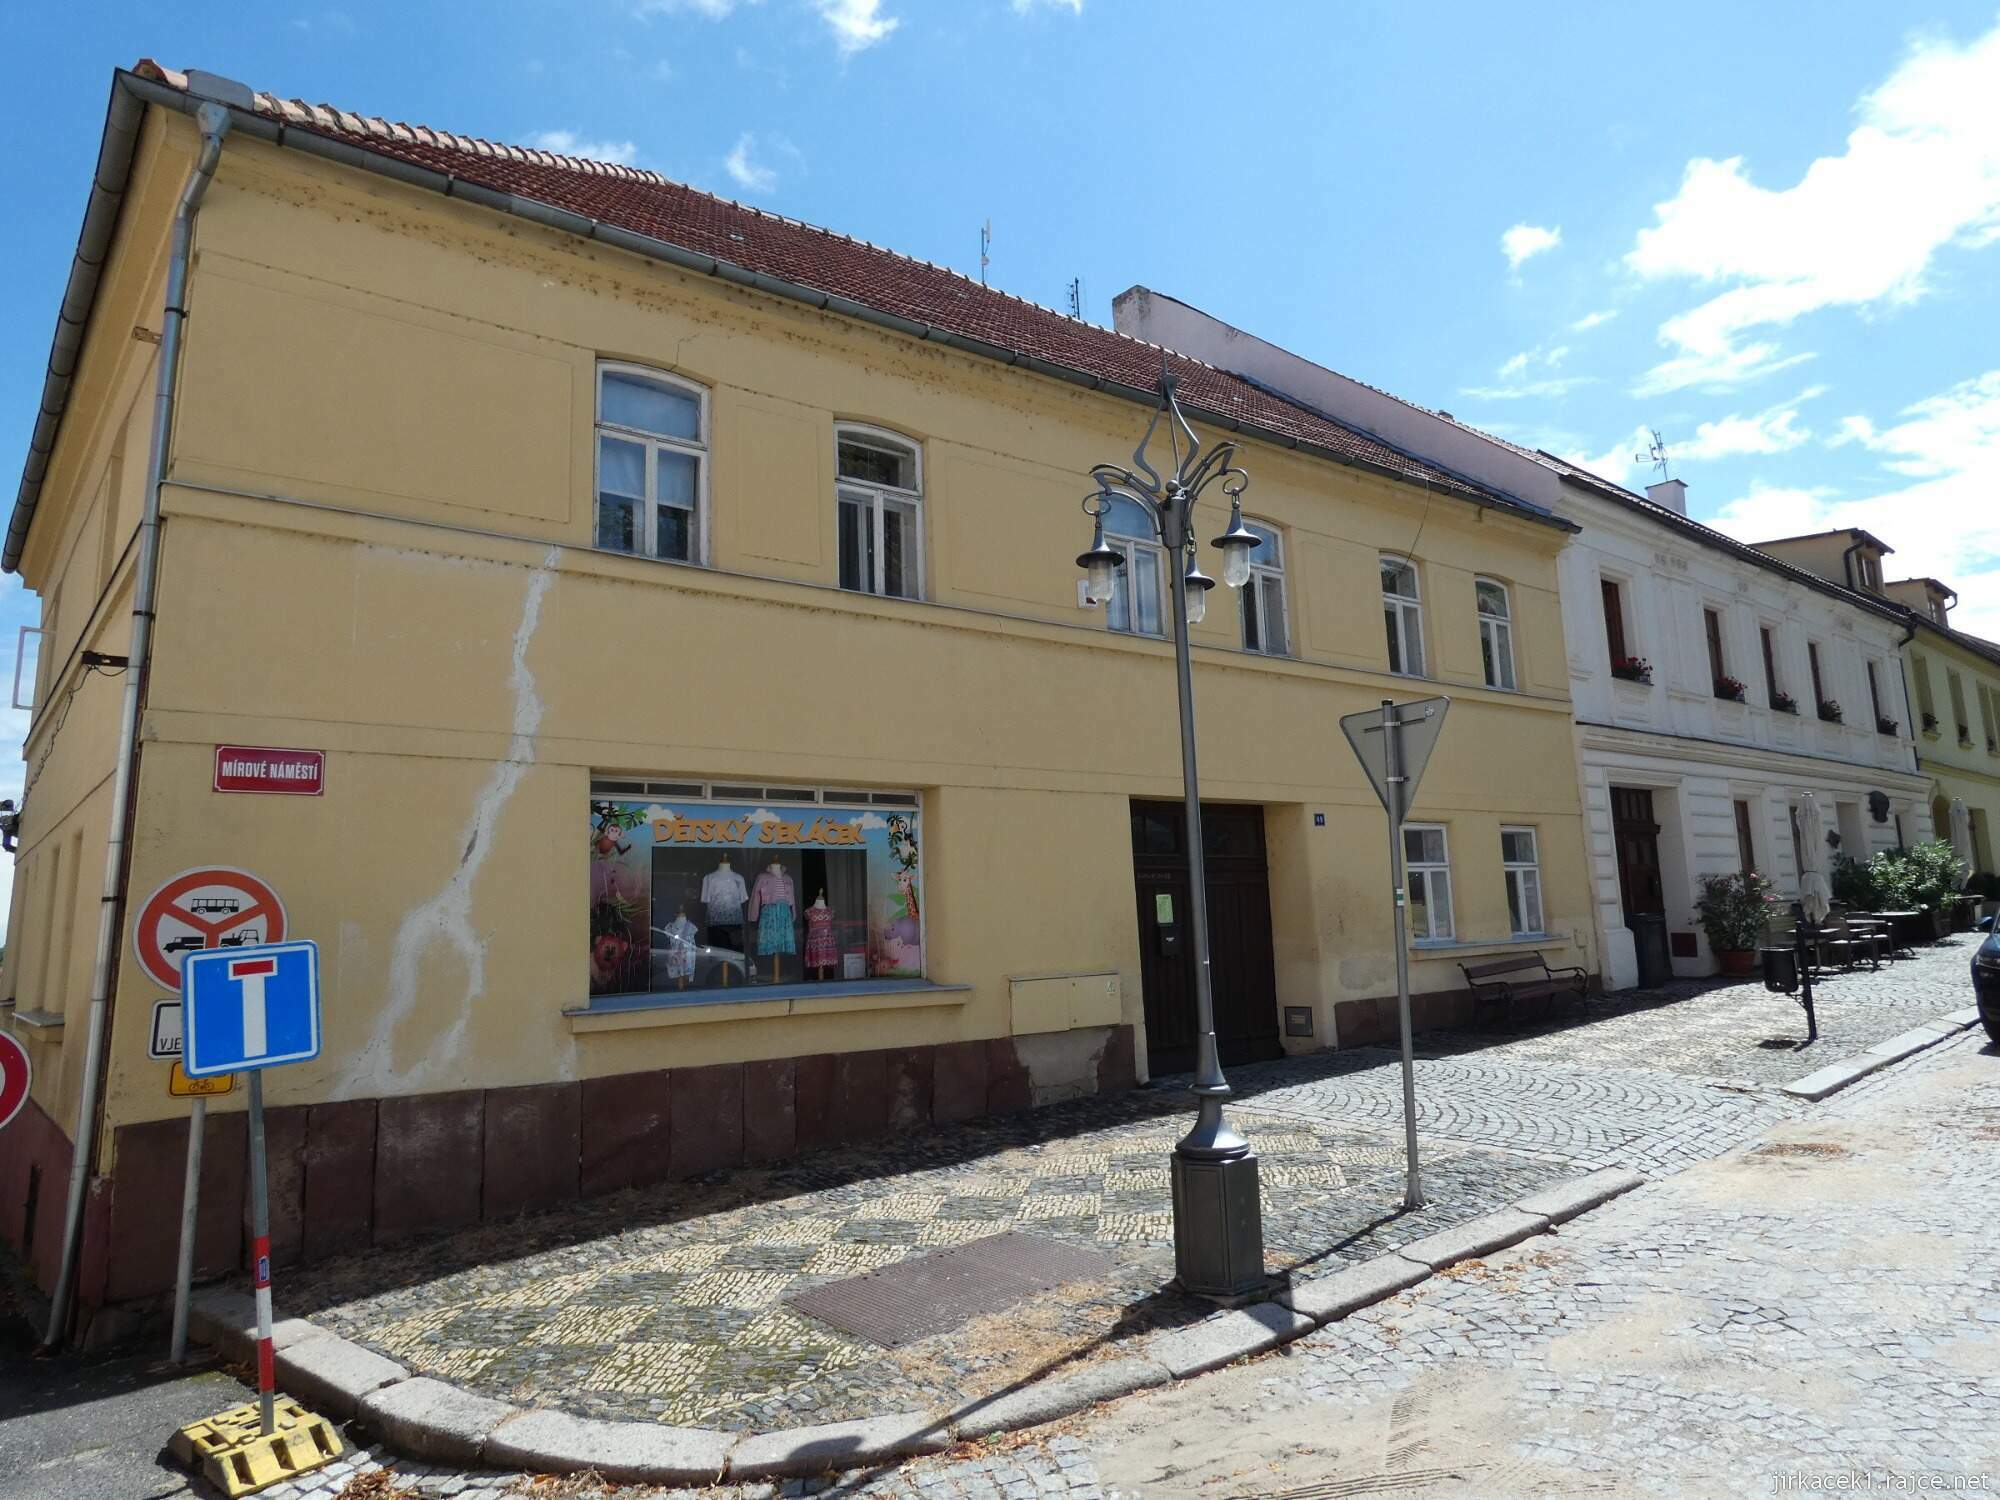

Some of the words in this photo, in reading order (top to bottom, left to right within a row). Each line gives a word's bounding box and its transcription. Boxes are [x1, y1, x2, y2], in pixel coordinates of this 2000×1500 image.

[222, 759, 267, 778] MÍROVÉ
[269, 761, 319, 780] NÁMĚSTÍ
[652, 813, 752, 844] DĚTSKÝ
[758, 816, 866, 845] SEKÁČEK
[160, 1037, 182, 1051] VJE
